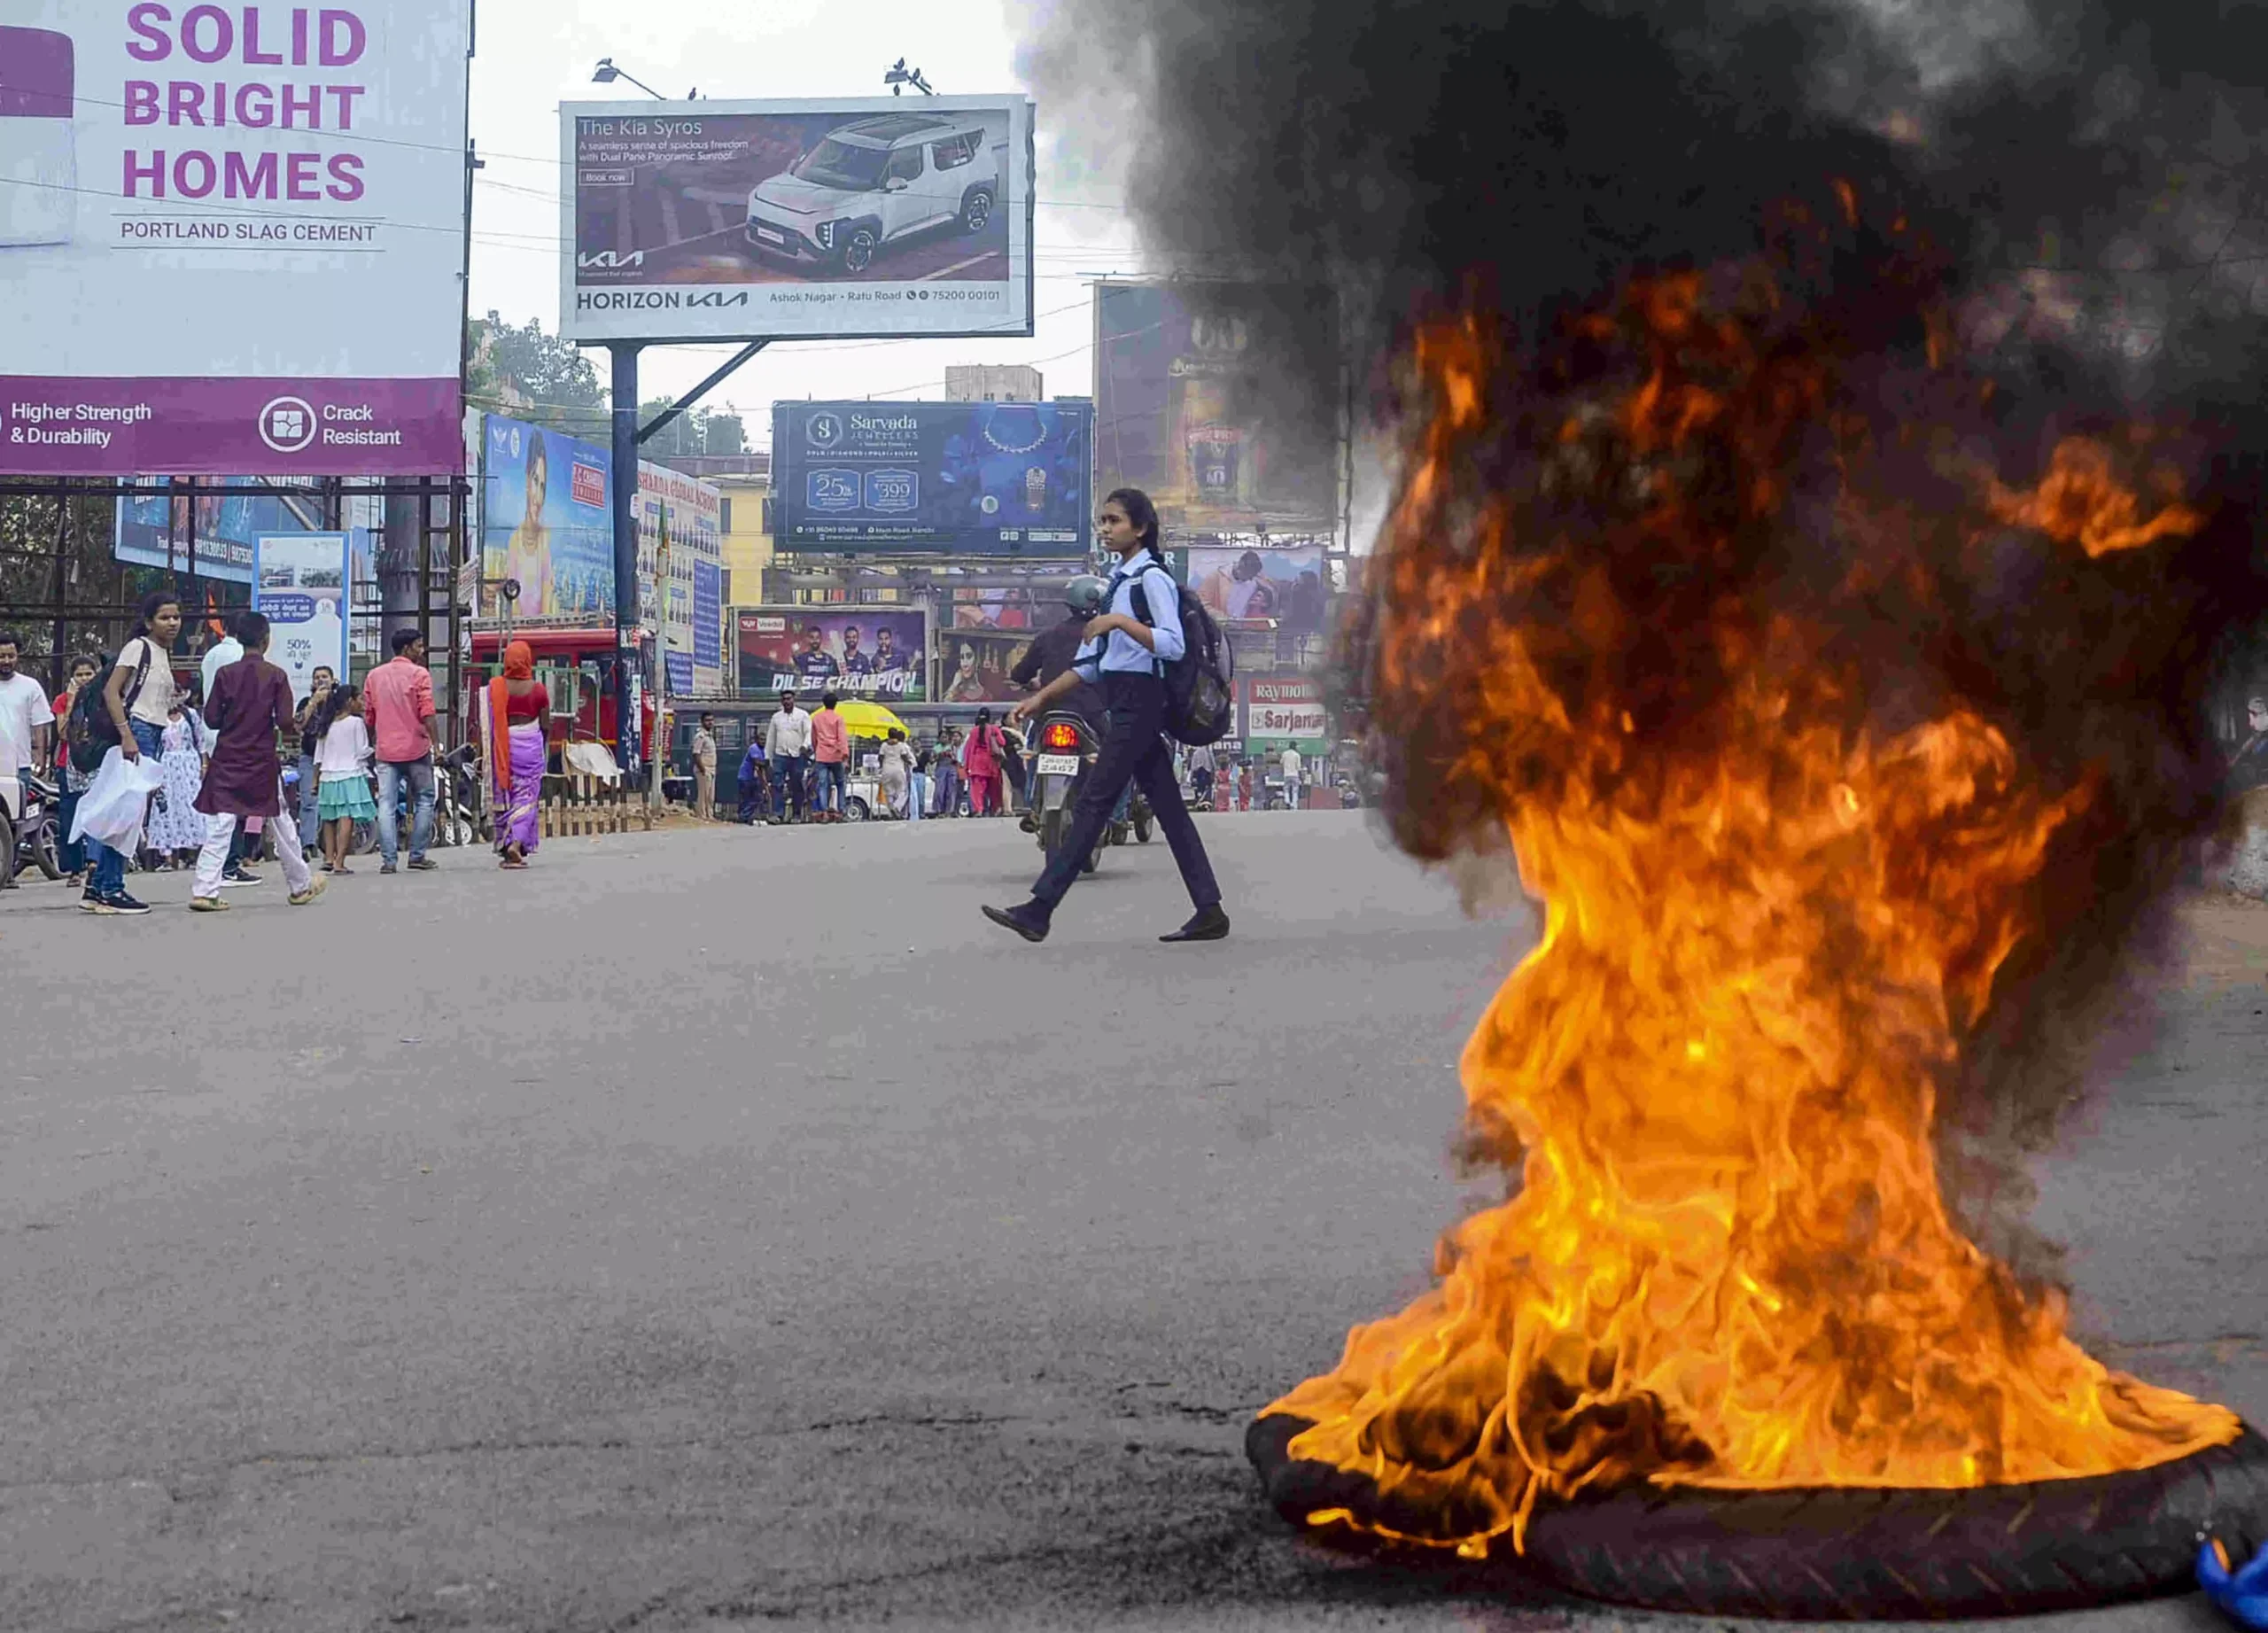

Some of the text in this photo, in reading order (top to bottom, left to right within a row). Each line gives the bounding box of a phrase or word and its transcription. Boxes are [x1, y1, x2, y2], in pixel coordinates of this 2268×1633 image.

[126, 3, 366, 66] SOLID
[124, 81, 365, 130] BRIGHT
[579, 119, 703, 138] The Kia Syros
[579, 142, 586, 151] A
[588, 141, 629, 151] seamless
[658, 140, 667, 149] of
[670, 140, 709, 152] spacious
[711, 139, 749, 149] freedom
[601, 152, 621, 161] Dual
[648, 152, 695, 161] Panoramic
[123, 150, 365, 201] HOMES
[120, 222, 377, 242] PORTLAND SLAG CEMENT
[578, 292, 680, 309] HORIZON
[770, 292, 801, 302] Ashok
[804, 292, 836, 304] Nagar
[848, 292, 872, 301] Ratu
[875, 291, 902, 300] Road
[933, 291, 963, 300] 75200
[967, 290, 1000, 300] 00101
[11, 402, 151, 424] Higher Strength
[323, 404, 373, 421] Crack
[851, 413, 918, 430] Sarvada
[11, 427, 111, 447] & Durability
[323, 428, 401, 445] Resistant
[287, 639, 311, 649] 50%
[772, 669, 917, 693] DIL SE CHAMPION
